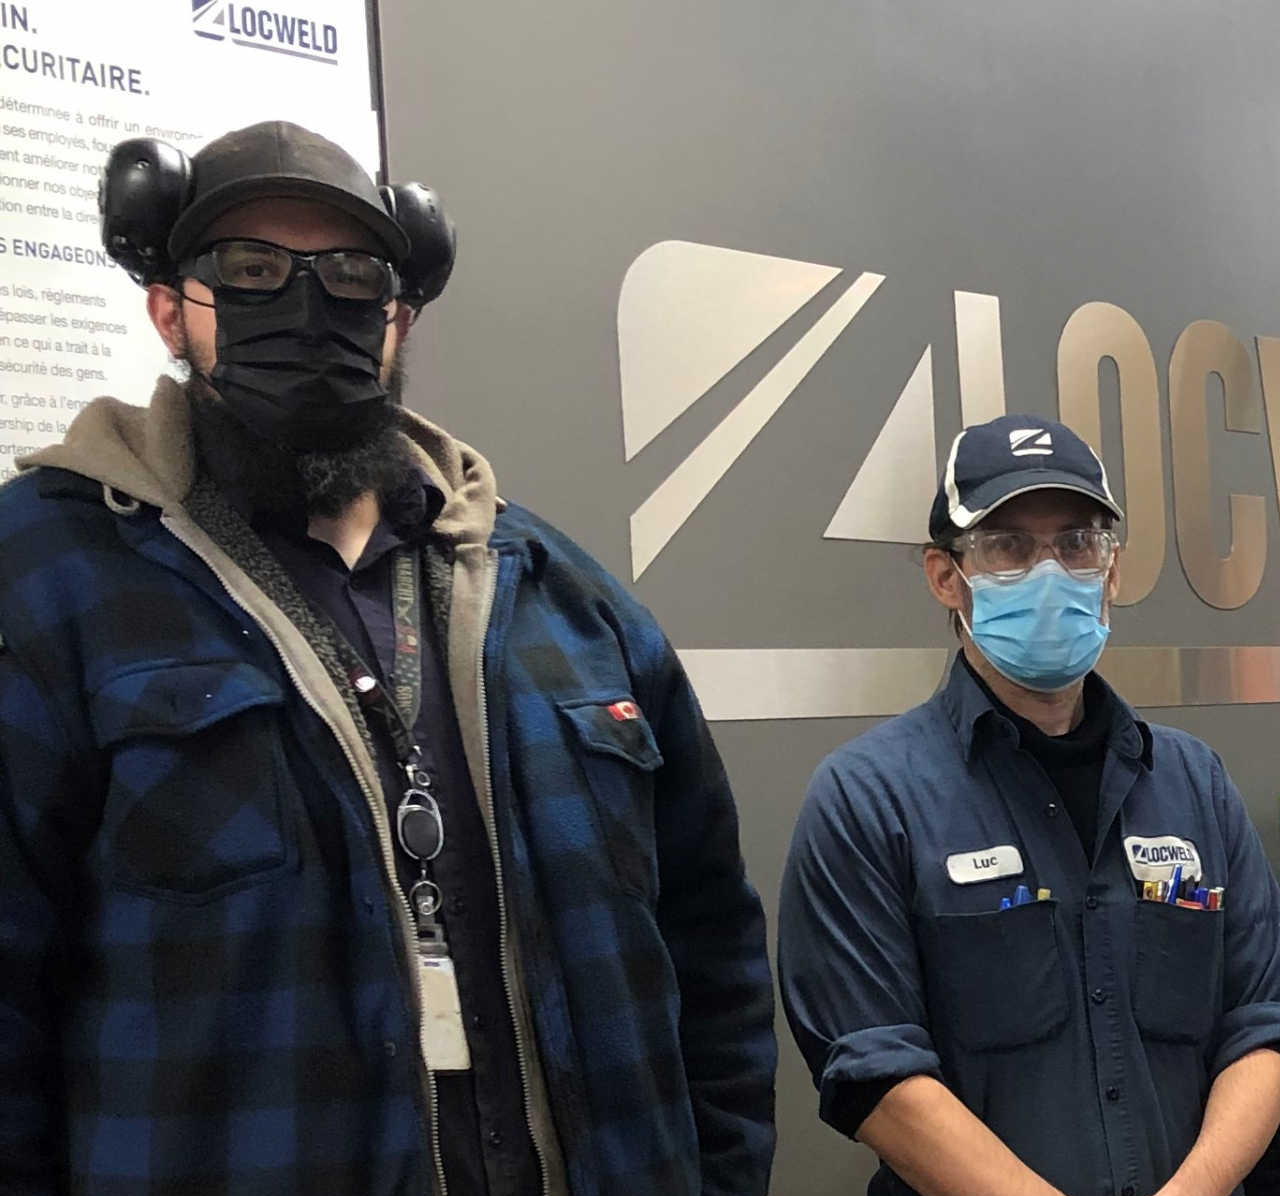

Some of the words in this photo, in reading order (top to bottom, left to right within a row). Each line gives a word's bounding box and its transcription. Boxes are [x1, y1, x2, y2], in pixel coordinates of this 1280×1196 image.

[228, 3, 339, 55] LOCWELD
[0, 44, 150, 96] CURITAIRE.
[44, 181, 67, 195] nos
[26, 204, 59, 219] entre
[50, 312, 68, 328] les
[50, 363, 73, 378] des
[37, 419, 53, 433] de
[972, 855, 999, 870] Luc
